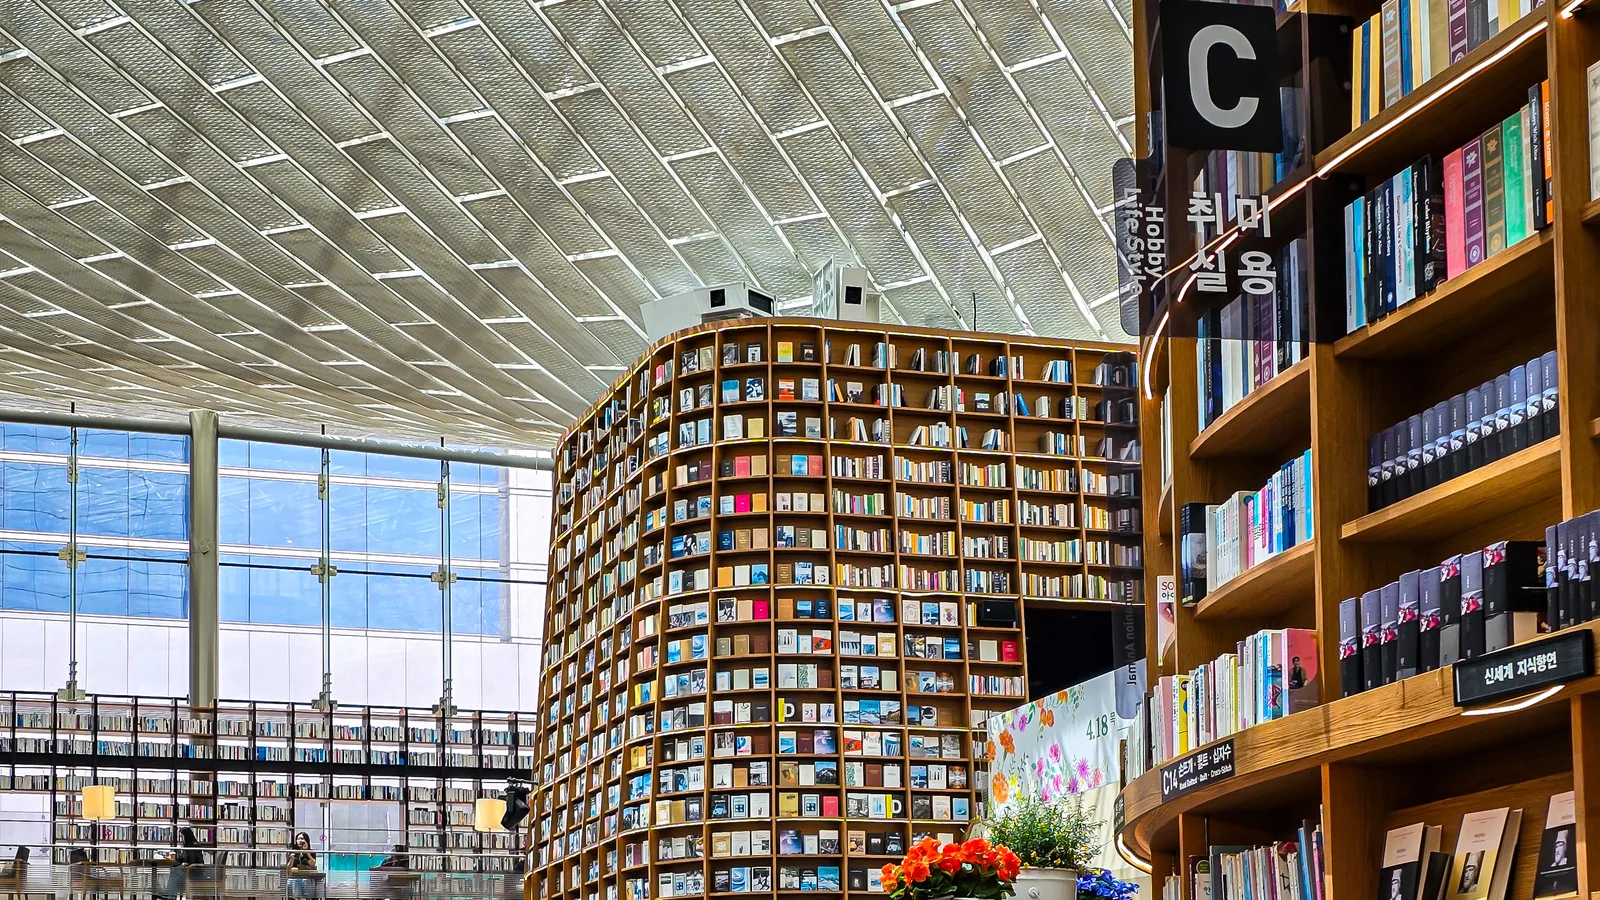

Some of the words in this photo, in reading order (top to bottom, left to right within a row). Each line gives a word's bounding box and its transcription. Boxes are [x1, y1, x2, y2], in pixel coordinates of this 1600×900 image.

[1188, 24, 1259, 128] C
[1124, 188, 1142, 230] Life
[1187, 191, 1271, 237] 취미
[1145, 207, 1165, 278] Hobby
[1125, 237, 1146, 295] Style
[1189, 250, 1276, 295] 실용
[1484, 662, 1514, 685] 신세계
[1517, 651, 1557, 676] 지식향연
[1086, 714, 1108, 740] 4.18
[1163, 769, 1178, 795] C14
